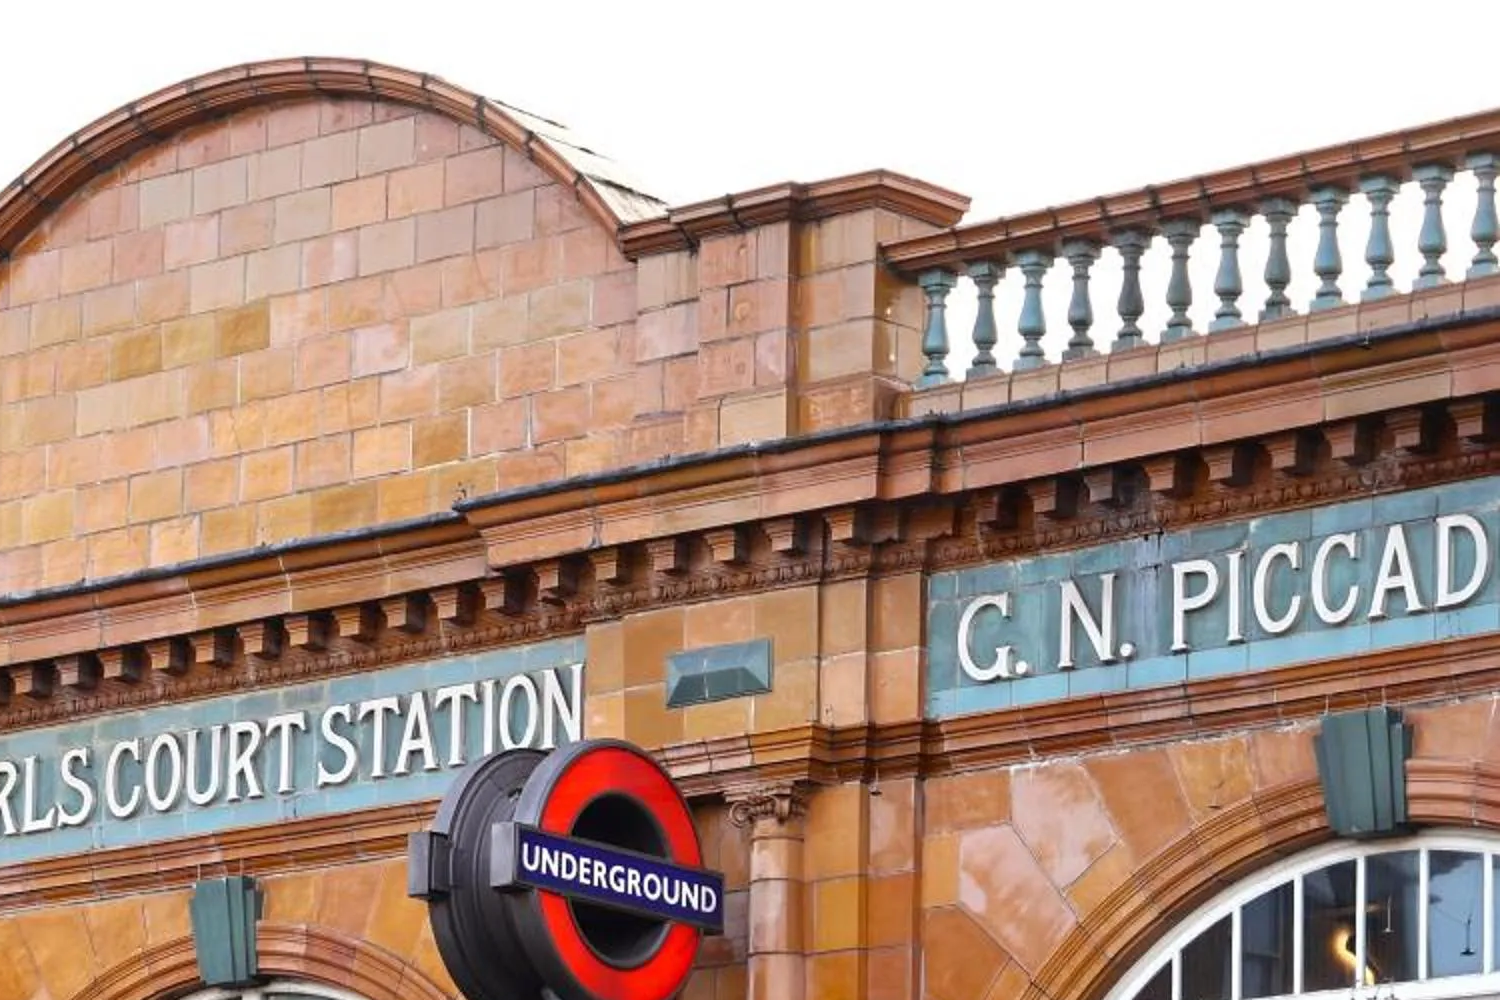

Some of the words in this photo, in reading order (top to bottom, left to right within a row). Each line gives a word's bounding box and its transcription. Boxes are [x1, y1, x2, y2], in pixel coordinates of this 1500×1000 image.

[1171, 515, 1489, 653] PICCAD
[105, 712, 306, 818] COURT
[318, 663, 584, 786] STATION
[521, 842, 717, 914] UNDERGROUND
